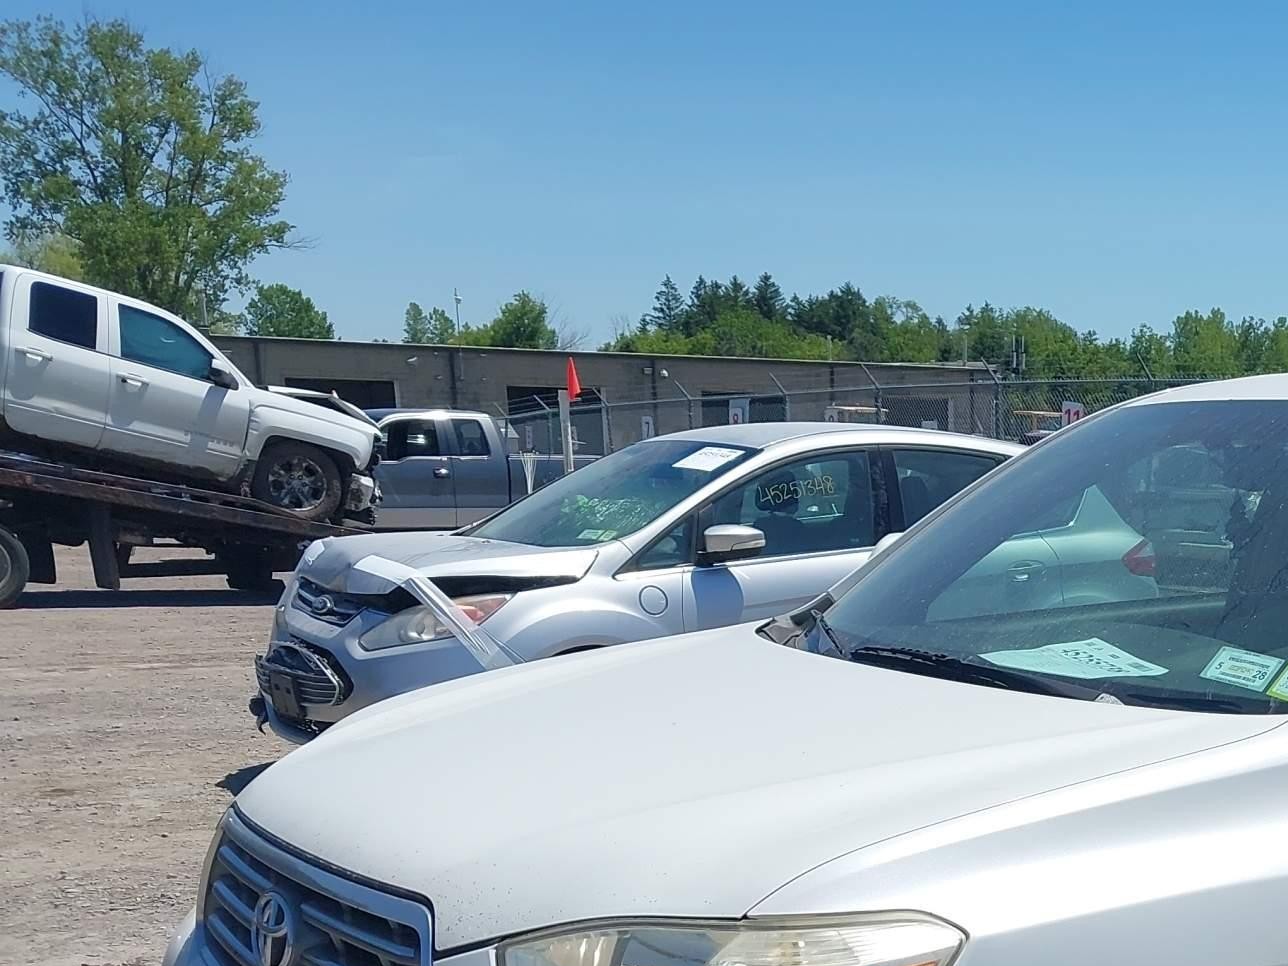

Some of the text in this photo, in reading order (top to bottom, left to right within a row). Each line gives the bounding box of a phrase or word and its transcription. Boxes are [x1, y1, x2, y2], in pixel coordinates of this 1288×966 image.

[757, 475, 835, 506] 45251348
[1215, 661, 1225, 670] 5
[1252, 669, 1268, 681] 28
